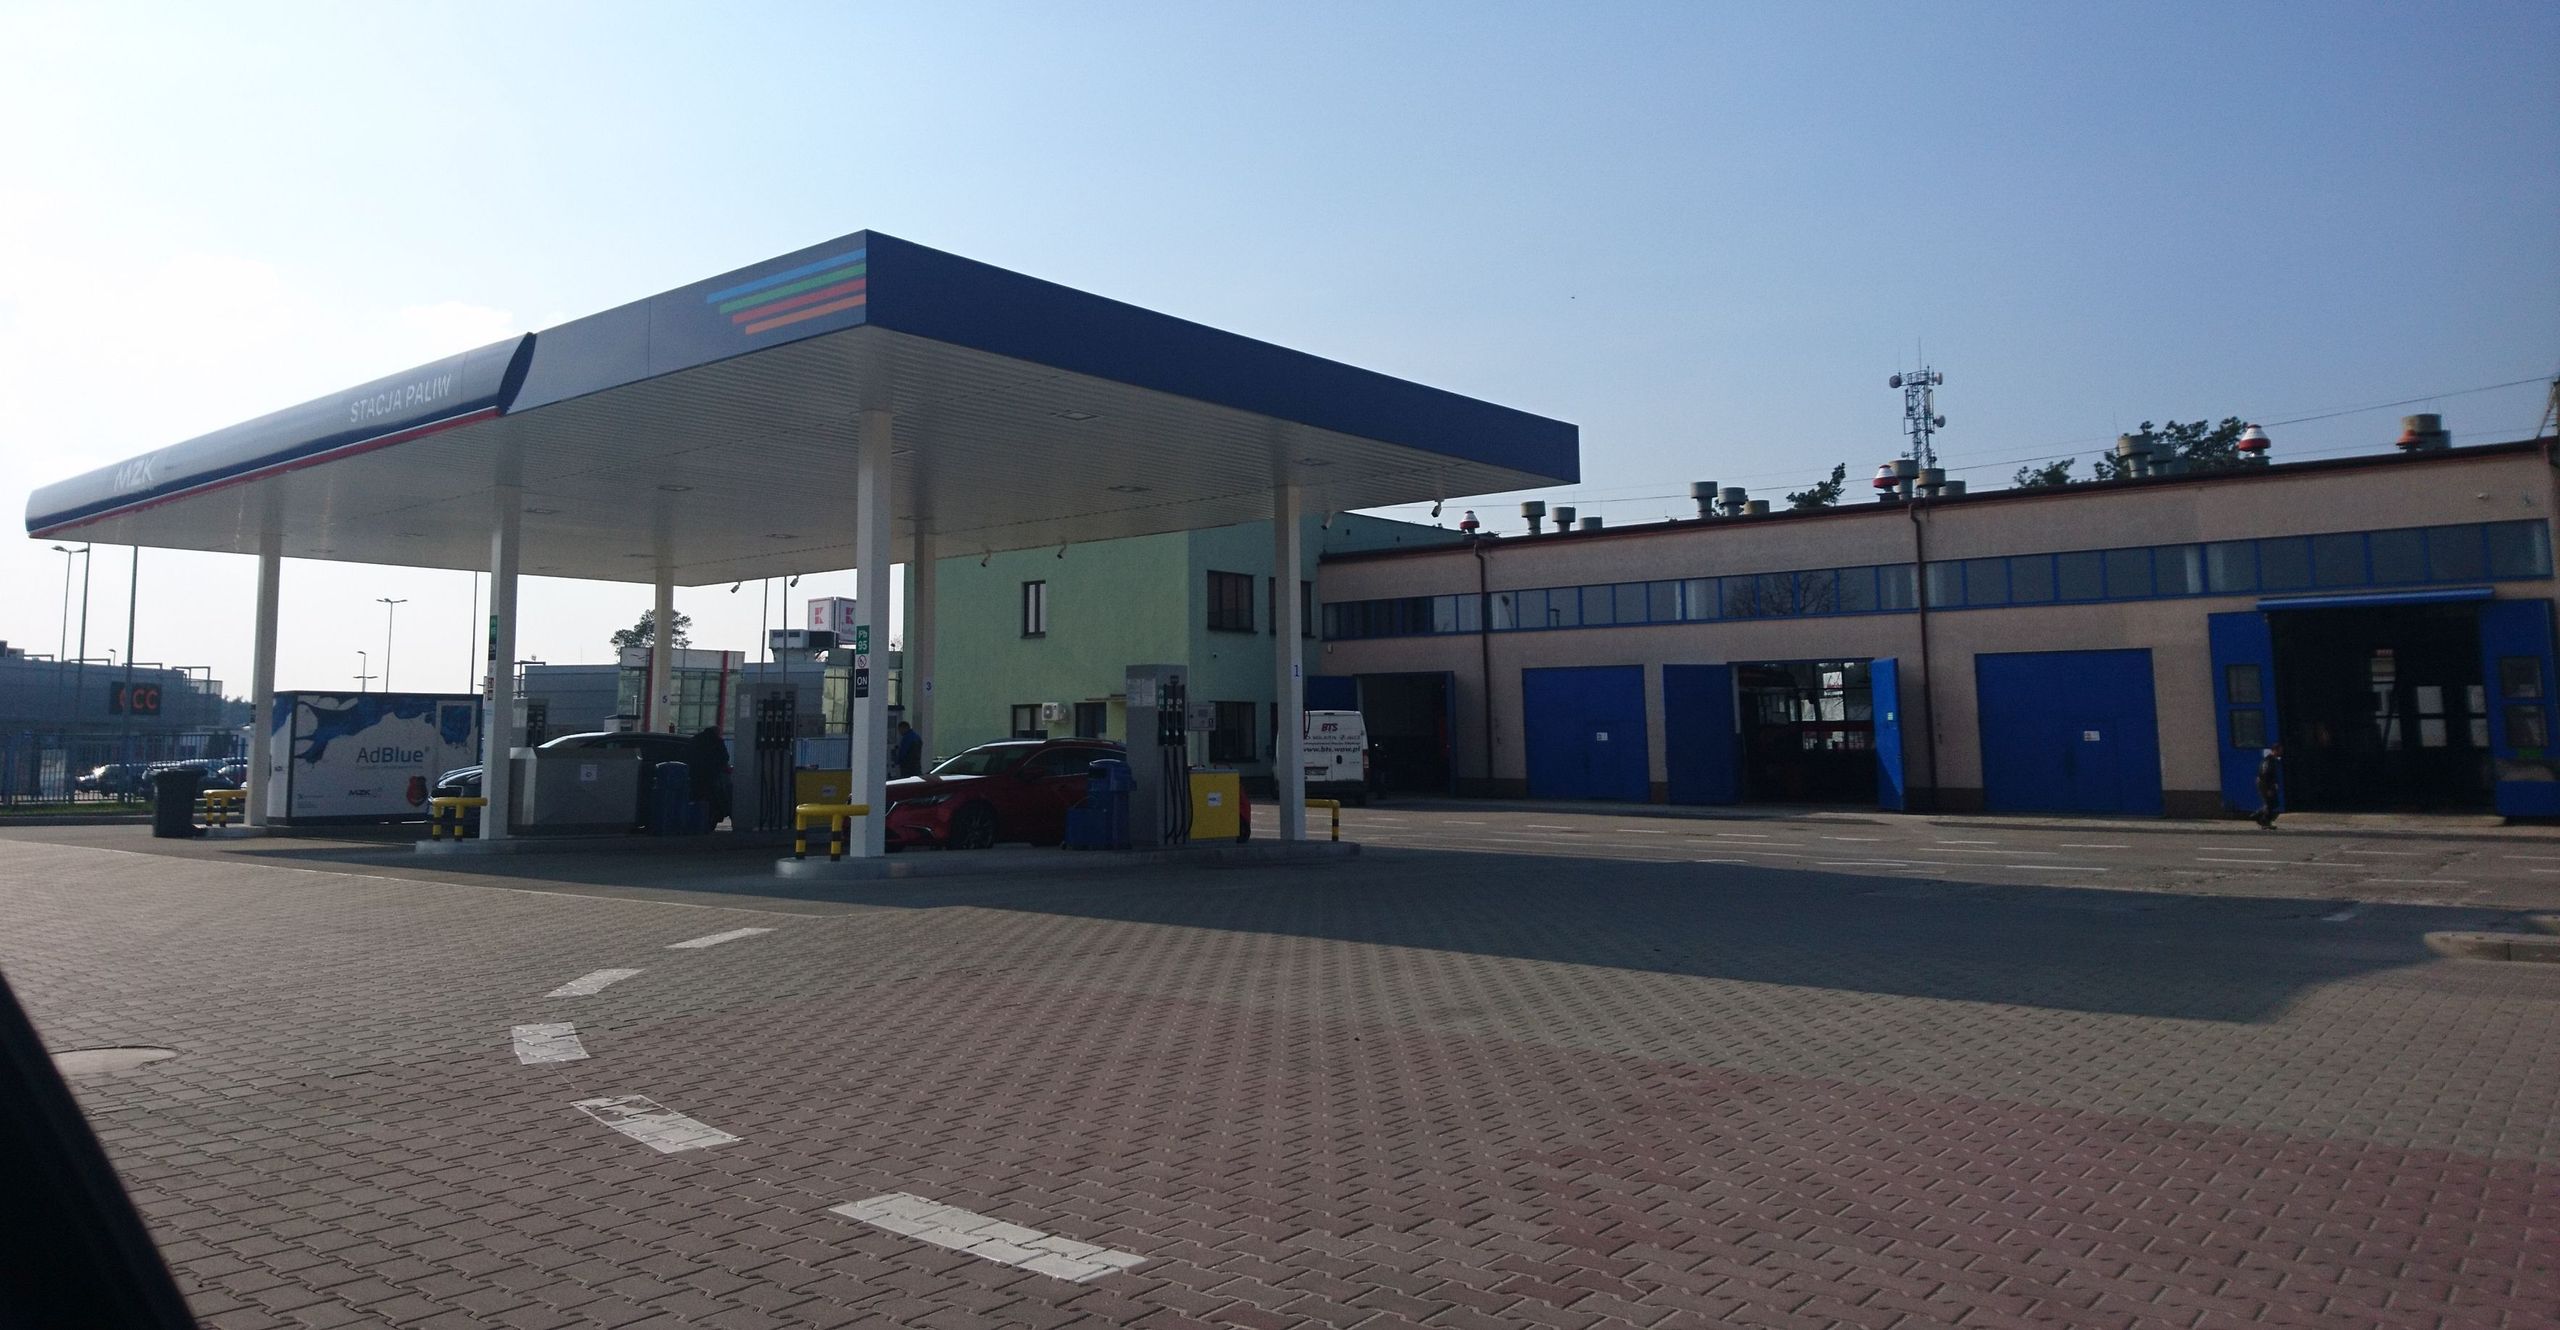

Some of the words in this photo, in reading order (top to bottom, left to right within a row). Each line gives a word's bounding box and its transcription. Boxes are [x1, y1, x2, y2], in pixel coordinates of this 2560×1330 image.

[350, 389, 402, 423] STACJA
[405, 373, 452, 409] PALIW
[113, 456, 156, 492] MZK
[858, 630, 868, 639] Pb
[858, 640, 868, 651] 95
[856, 676, 868, 686] ON
[926, 681, 932, 692] 3
[1321, 723, 1339, 732] BTS
[356, 746, 424, 764] AdBlue
